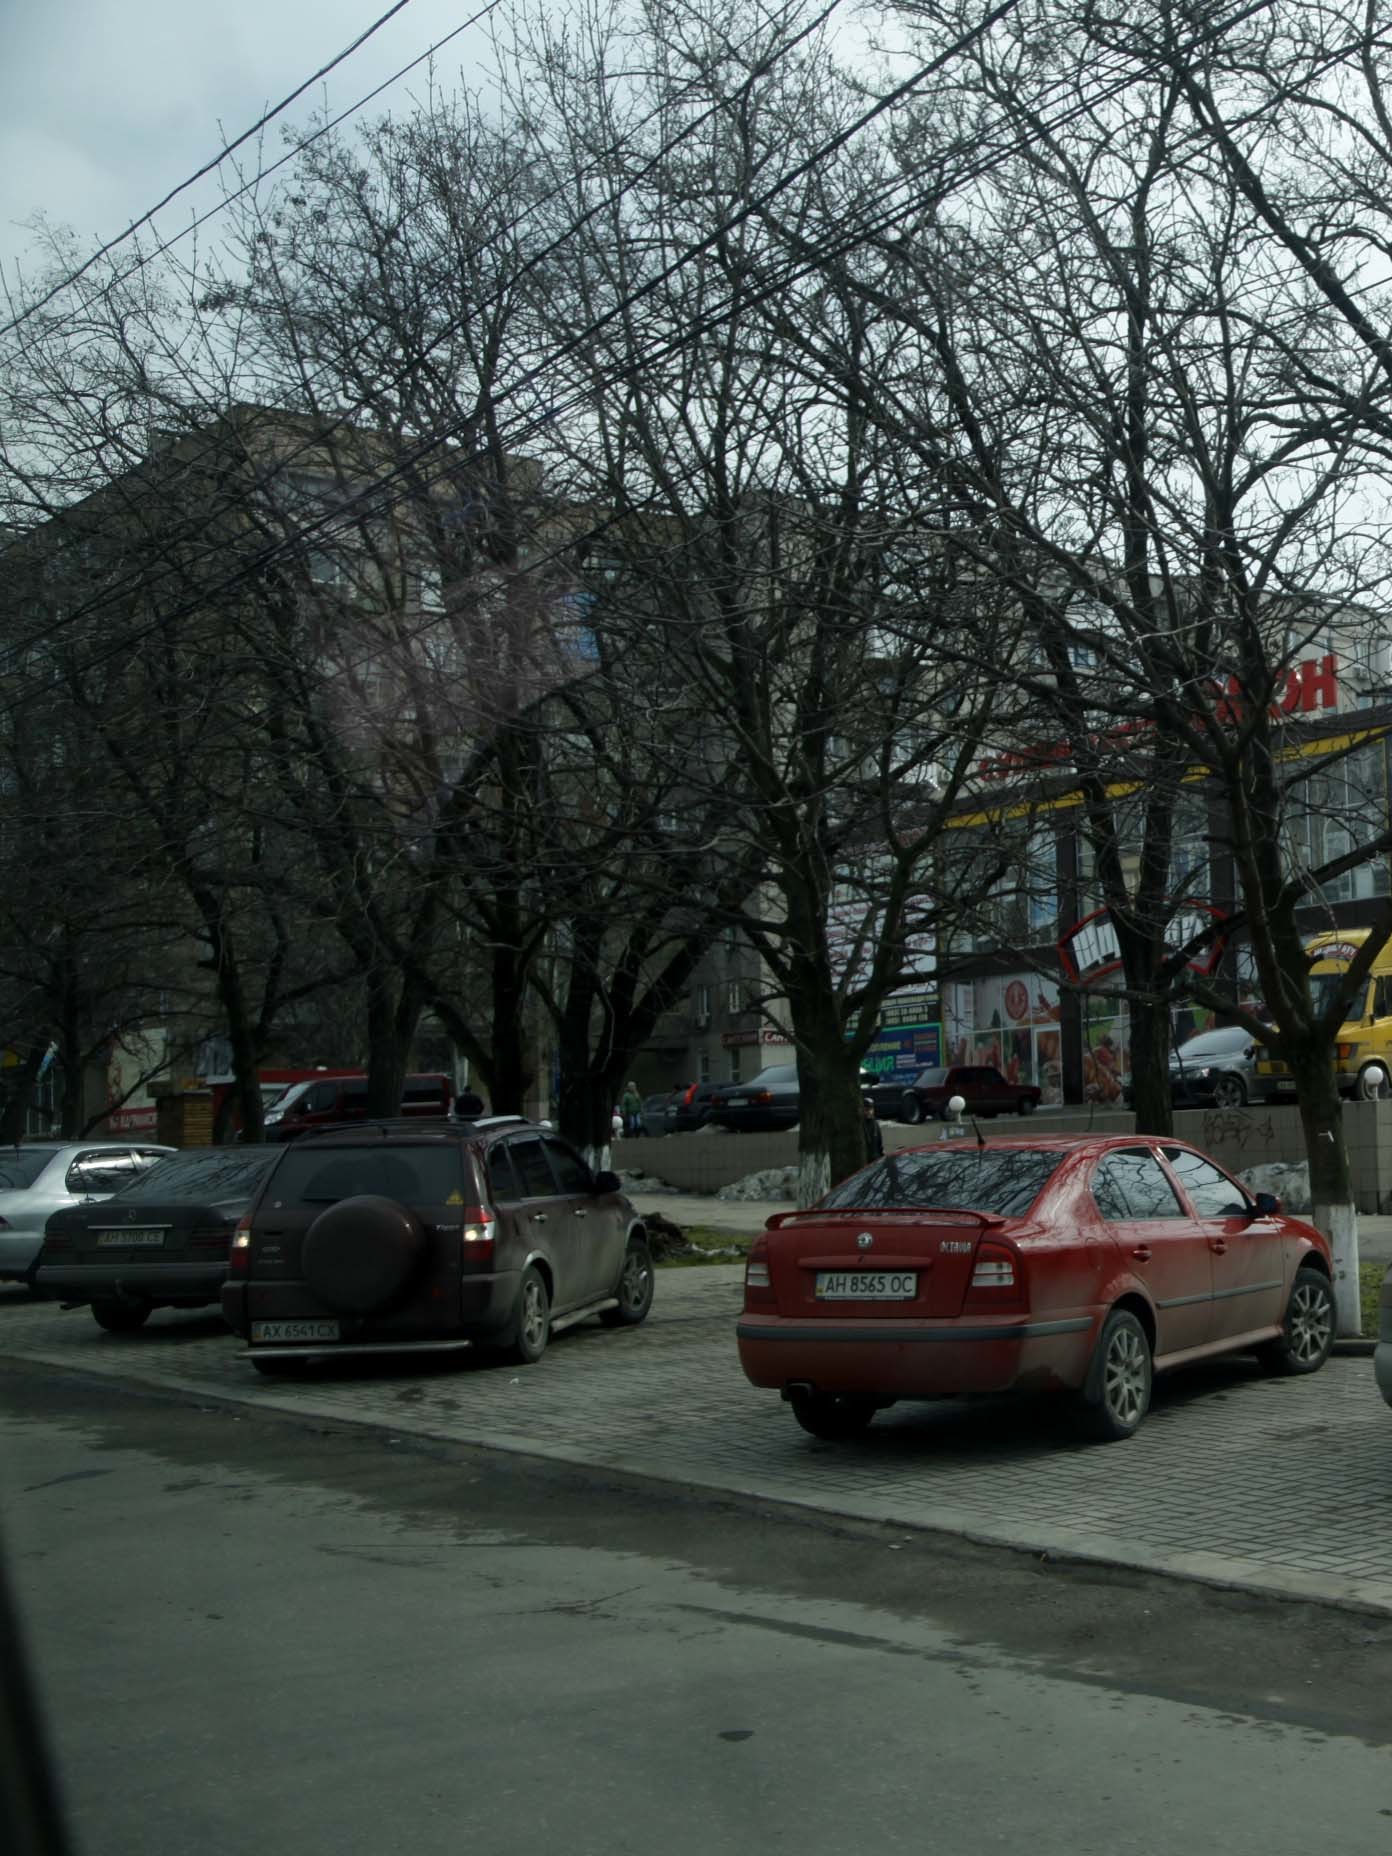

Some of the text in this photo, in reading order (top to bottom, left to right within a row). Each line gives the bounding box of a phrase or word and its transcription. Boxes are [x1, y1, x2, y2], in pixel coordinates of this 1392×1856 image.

[825, 1276, 912, 1293] AH 8565 OC
[263, 1325, 281, 1338] AX
